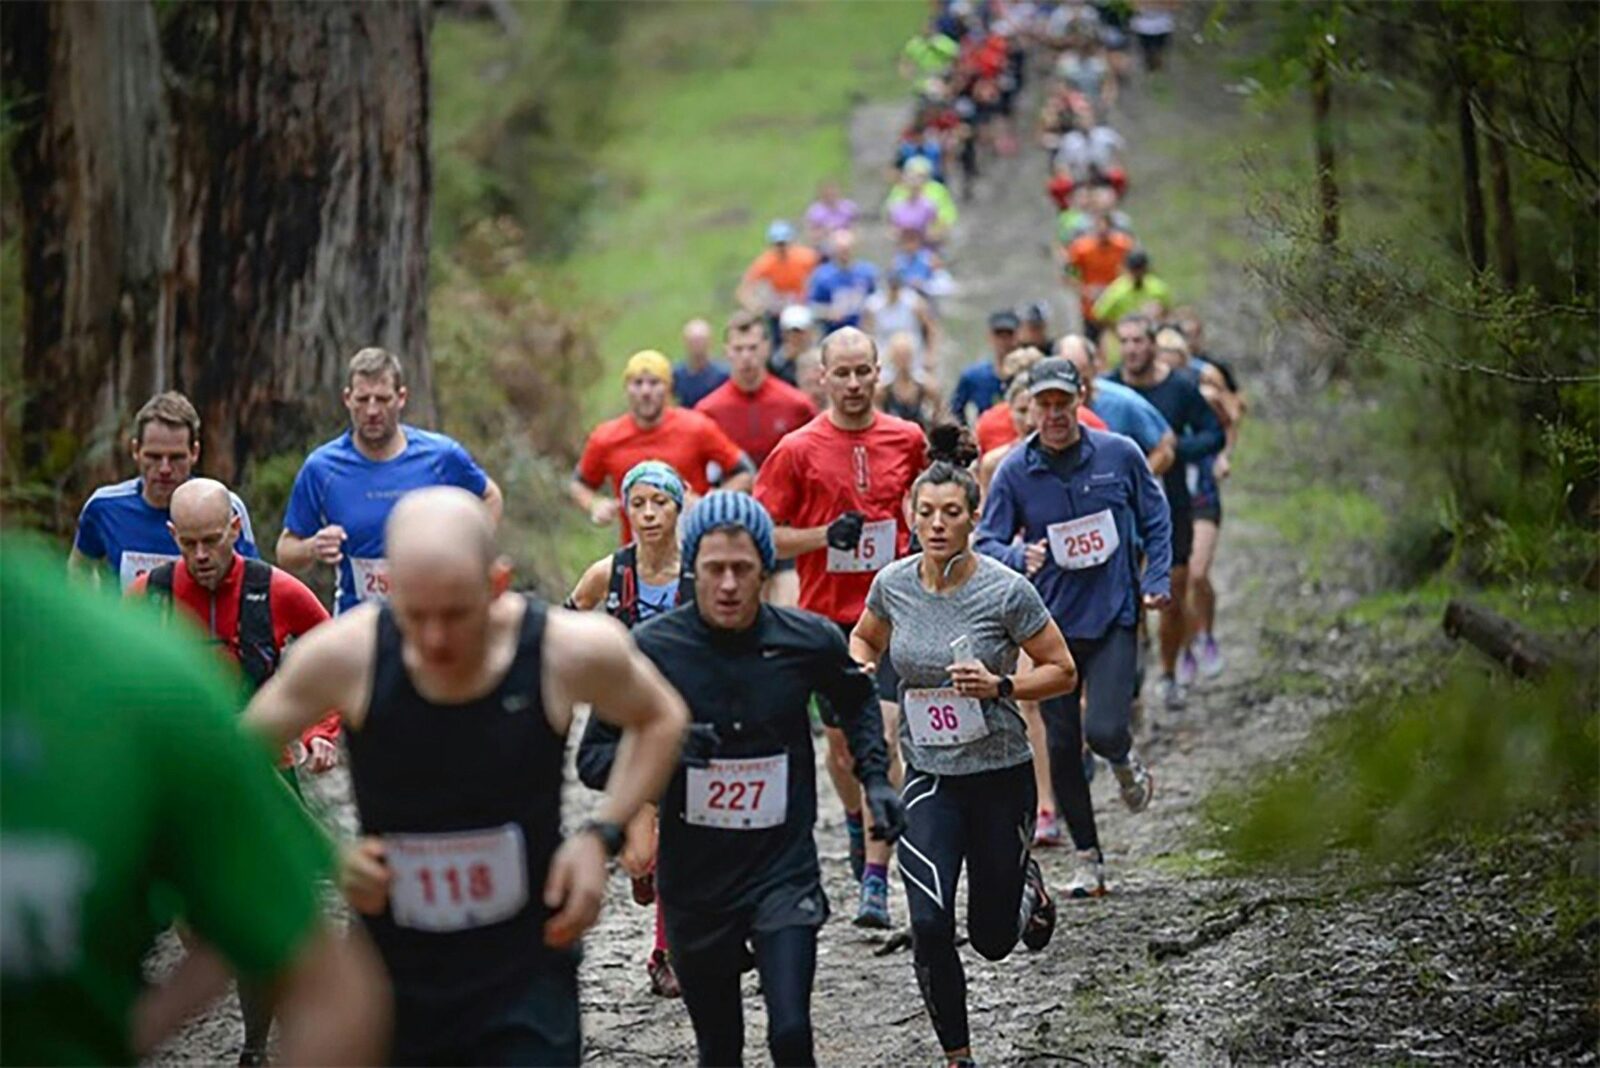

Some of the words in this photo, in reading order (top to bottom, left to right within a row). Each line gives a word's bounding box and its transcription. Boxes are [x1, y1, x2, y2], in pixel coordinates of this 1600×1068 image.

[1064, 530, 1104, 557] 255
[365, 573, 389, 593] 25
[928, 705, 958, 731] 36
[708, 780, 765, 810] 227
[418, 863, 493, 905] 118
